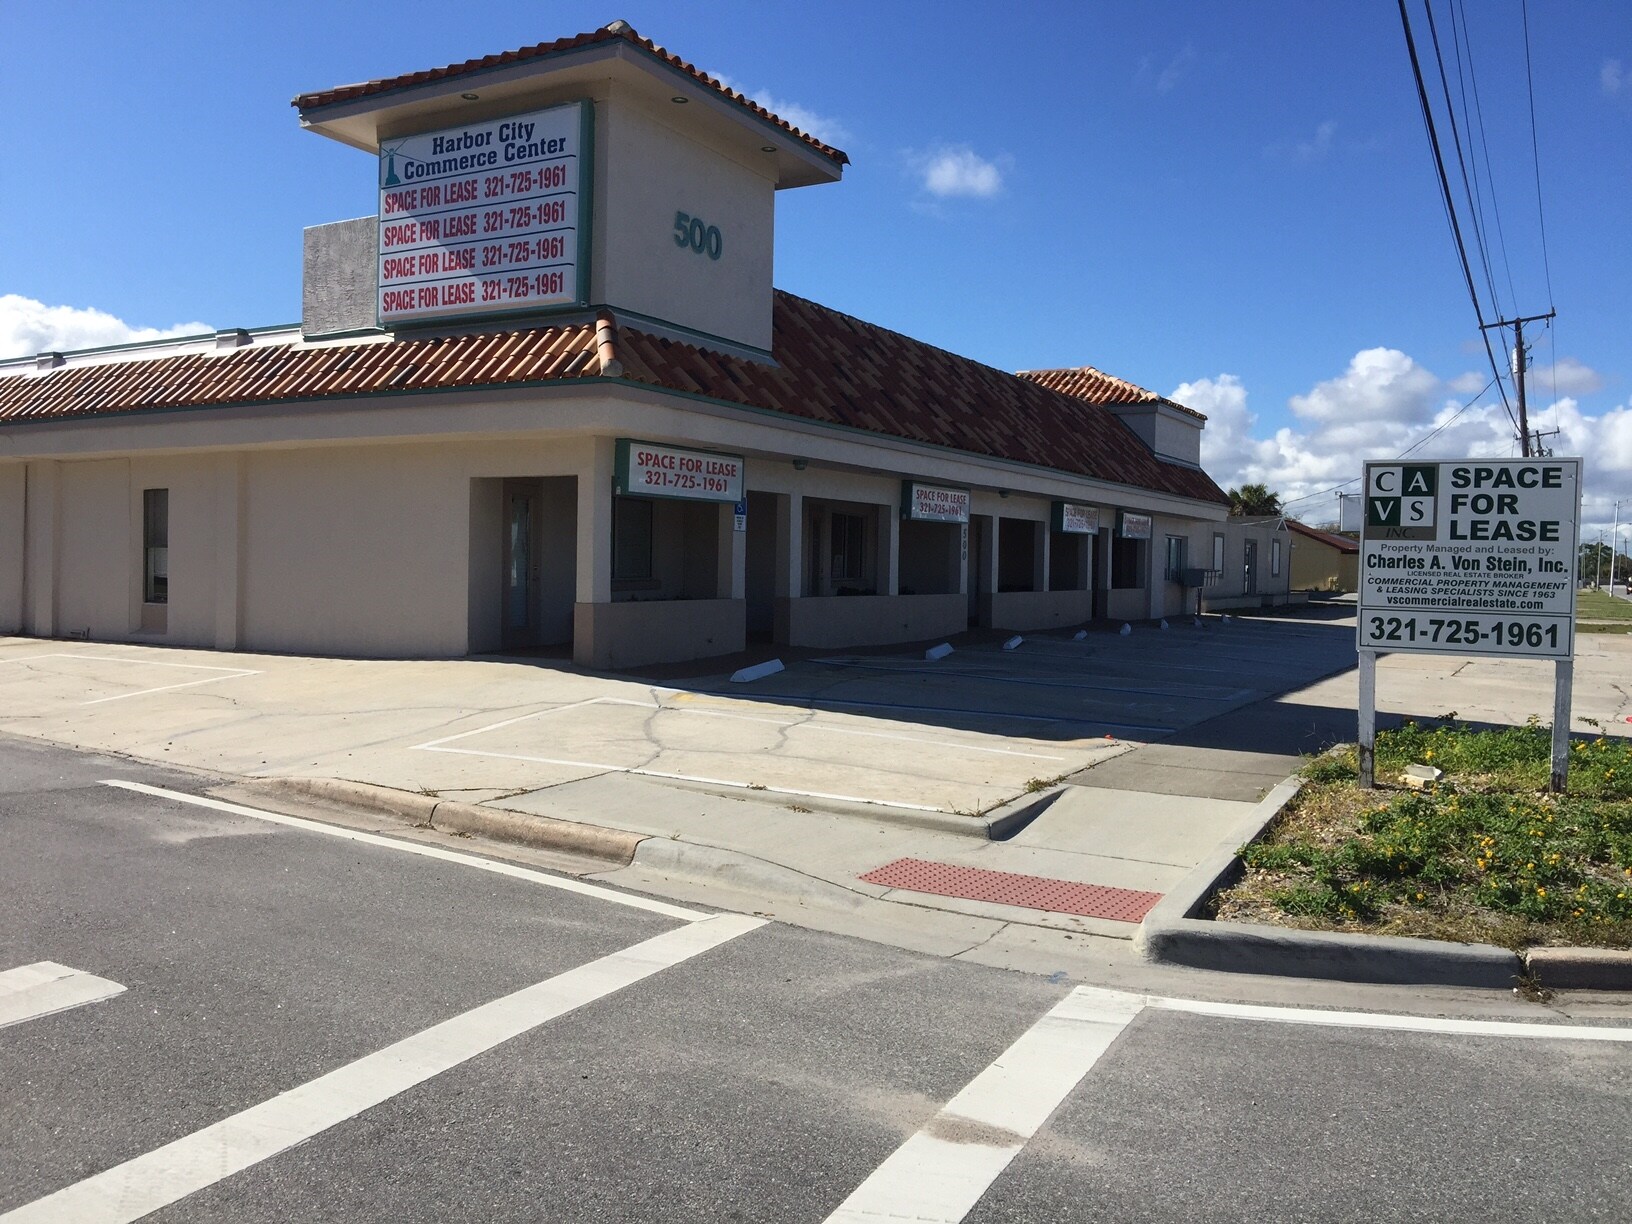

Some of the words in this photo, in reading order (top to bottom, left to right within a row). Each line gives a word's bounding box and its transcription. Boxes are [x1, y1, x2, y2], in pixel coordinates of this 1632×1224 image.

[432, 131, 492, 155] Harbor
[499, 122, 535, 142] City
[404, 149, 498, 180] Commerce
[504, 137, 567, 161] Center
[385, 188, 417, 214] SPACE
[420, 185, 441, 208] FOR
[444, 179, 478, 205] LEASE
[484, 165, 566, 199] 321-725-1961
[384, 221, 417, 247] SPACE
[419, 219, 440, 241] FOR
[443, 214, 477, 238] LEASE
[483, 200, 565, 233] 321-725-1961
[674, 211, 722, 260] 500
[383, 256, 416, 280] SPACE
[418, 253, 439, 275] FOR
[442, 248, 476, 272] LEASE
[482, 236, 564, 267] 321-725-1961
[383, 290, 415, 312] SPACE
[418, 287, 439, 308] FOR
[442, 281, 475, 306] LEASE
[481, 272, 564, 301] 321-725-1961
[637, 452, 675, 470] SPACE
[679, 457, 703, 473] FOR
[706, 461, 737, 478] LEASE
[645, 470, 728, 493] 321-725-1961
[1450, 467, 1563, 489] SPACE
[916, 489, 935, 501] SPACE
[937, 492, 949, 502] FOR
[950, 493, 966, 505] LEASE
[1450, 493, 1519, 515] FOR
[1385, 527, 1415, 539] INC.
[1449, 520, 1560, 542] LEASE
[1380, 543, 1423, 554] Property
[1426, 544, 1472, 554] Managed
[1474, 546, 1494, 554] and
[1497, 546, 1535, 554] Leased
[1538, 546, 1555, 555] by:
[1367, 554, 1425, 570] Charles
[1429, 555, 1446, 570] A.
[1452, 556, 1480, 571] Von
[1486, 556, 1533, 574] Stein,
[1538, 557, 1569, 573] Inc.
[1367, 577, 1434, 586] COMMERCIAL
[1436, 579, 1490, 588] PROPERTY
[1492, 580, 1567, 590] MANAGEMENT
[1386, 586, 1428, 595] LEASING
[1431, 587, 1494, 597] SPECIALISTS
[1497, 589, 1528, 598] SINCE
[1387, 596, 1544, 610] vscommercialrealestate.com
[1369, 617, 1558, 648] 321-725-1961
